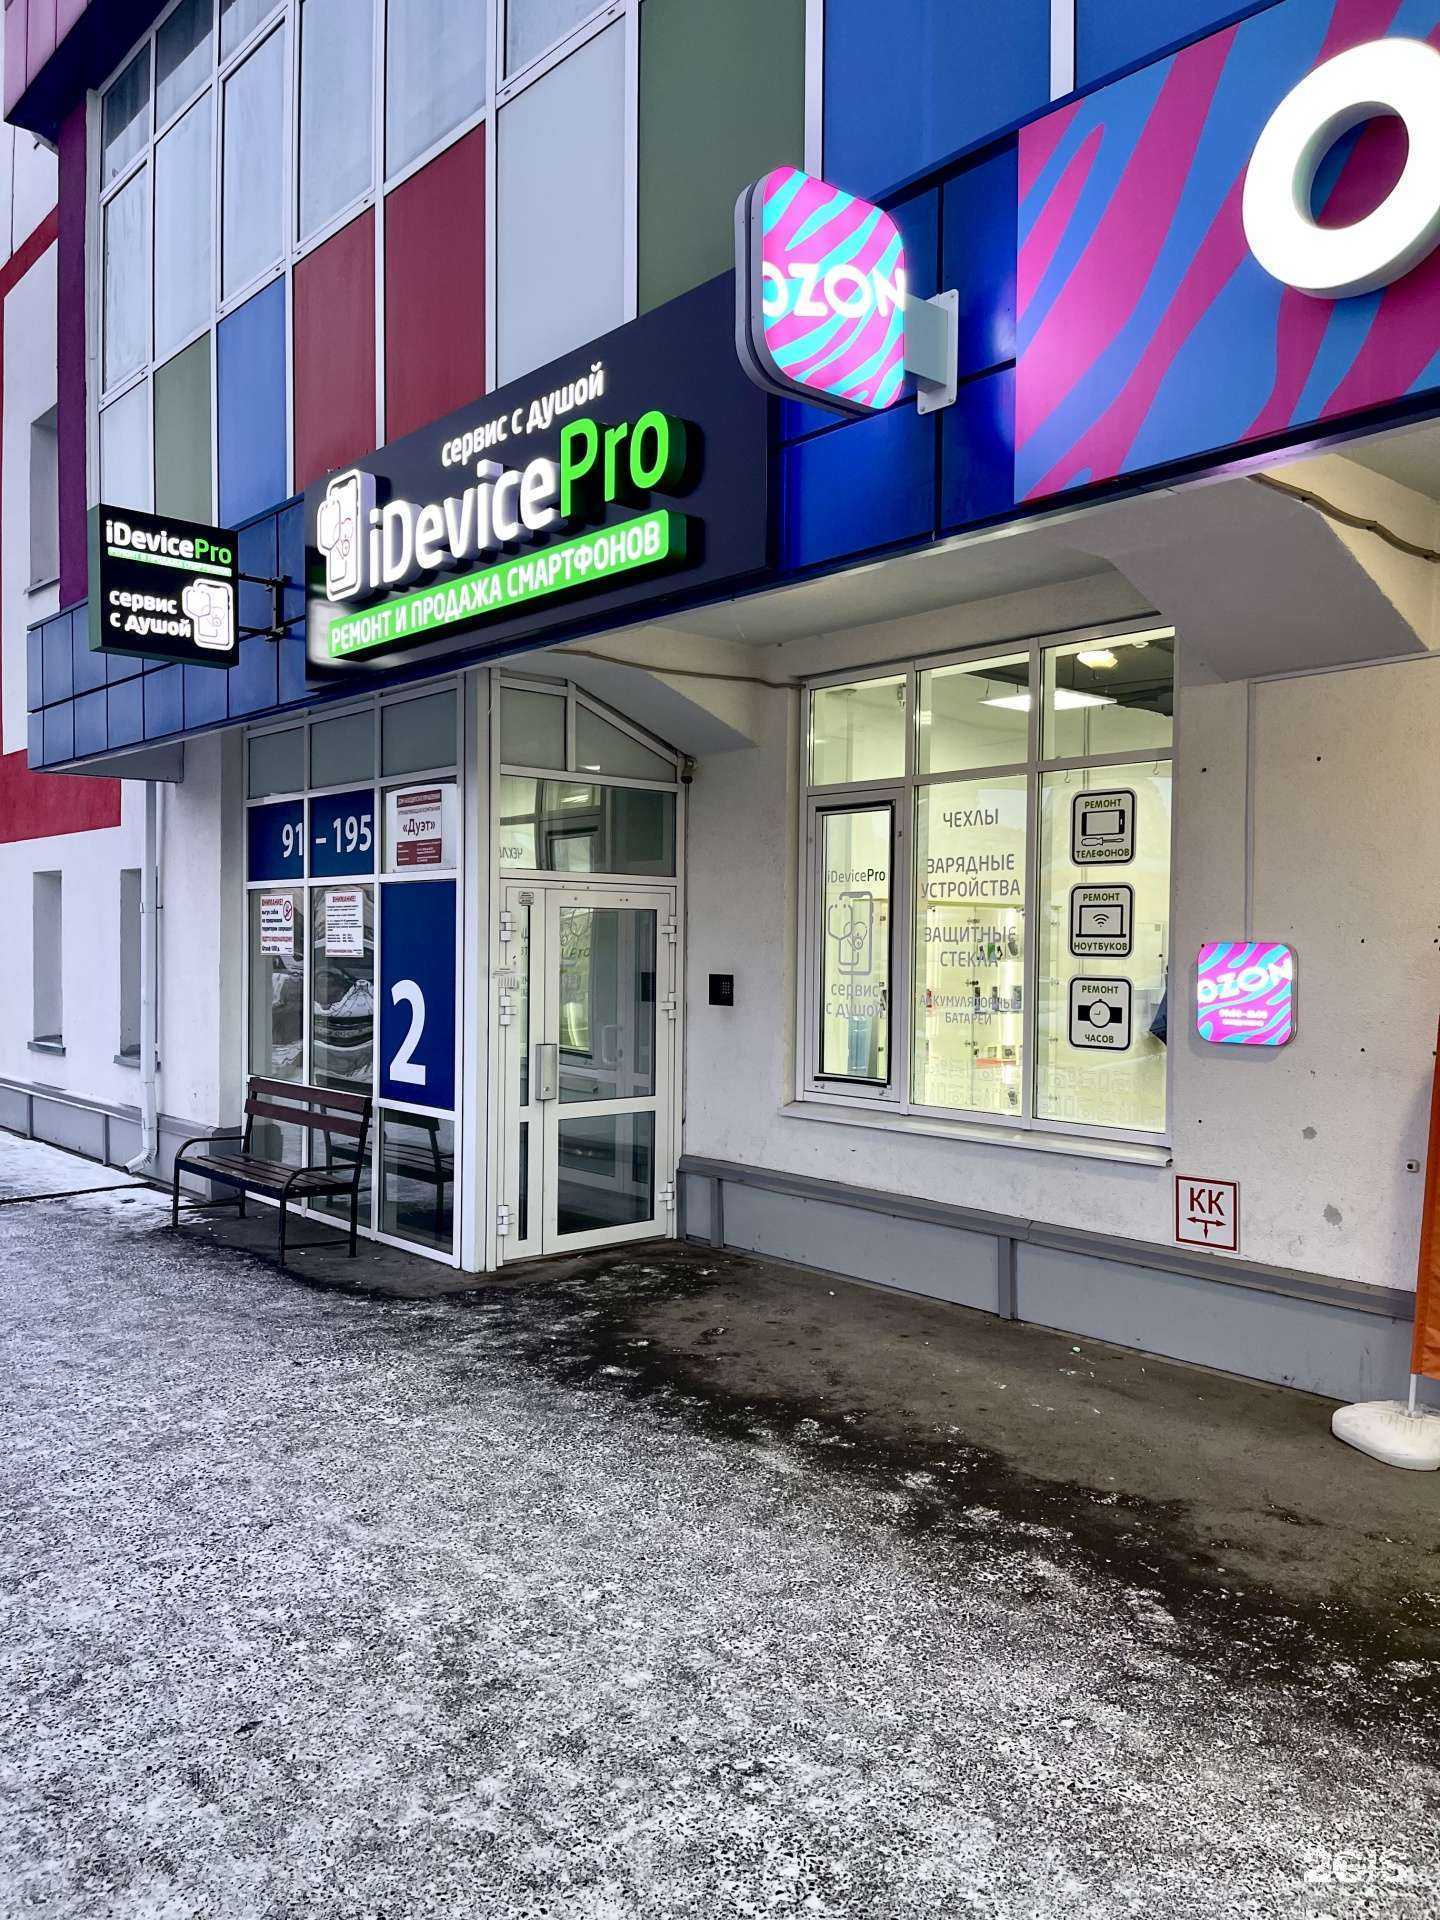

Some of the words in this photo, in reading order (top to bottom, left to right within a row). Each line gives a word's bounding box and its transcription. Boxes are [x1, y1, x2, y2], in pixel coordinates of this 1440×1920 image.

[763, 261, 906, 318] OZON
[441, 417, 508, 468] сервис
[511, 408, 523, 434] с
[526, 361, 605, 434] душой
[369, 410, 670, 589] iDevicePro
[105, 520, 232, 564] iDevicePro
[330, 613, 392, 652] РЕМОНТ
[395, 609, 407, 632] И
[411, 577, 502, 628] ПРОДАЖА
[507, 520, 662, 598] СМАРТФОНОВ
[109, 590, 178, 615] сервис
[109, 612, 121, 627] с
[124, 615, 191, 638] душой
[1084, 799, 1122, 809] РЕМОНТ
[402, 818, 436, 836] «Дуэт»
[943, 808, 999, 828] ЧЕХЛЫ
[282, 822, 304, 858] 91
[333, 814, 372, 853] 195
[1076, 848, 1130, 859] ТЕЛЕФОНОВ
[926, 853, 1015, 875] ЗАРЯДНЫЕ
[827, 868, 886, 883] iDevicePro
[921, 876, 1021, 898] УСТРОЙСТВА
[1082, 892, 1121, 902] РЕМОНТ
[924, 926, 1017, 945] ЗАЩИТНЫЕ
[1073, 941, 1127, 951] НОУТБУКОВ
[939, 951, 999, 968] СТЕКЛА
[1081, 985, 1119, 994] РЕМОНТ
[1197, 958, 1293, 1003] OZON
[831, 983, 879, 999] сервис
[826, 1002, 833, 1015] с
[389, 979, 426, 1086] 2
[1084, 1033, 1114, 1044] ЧАСОВ
